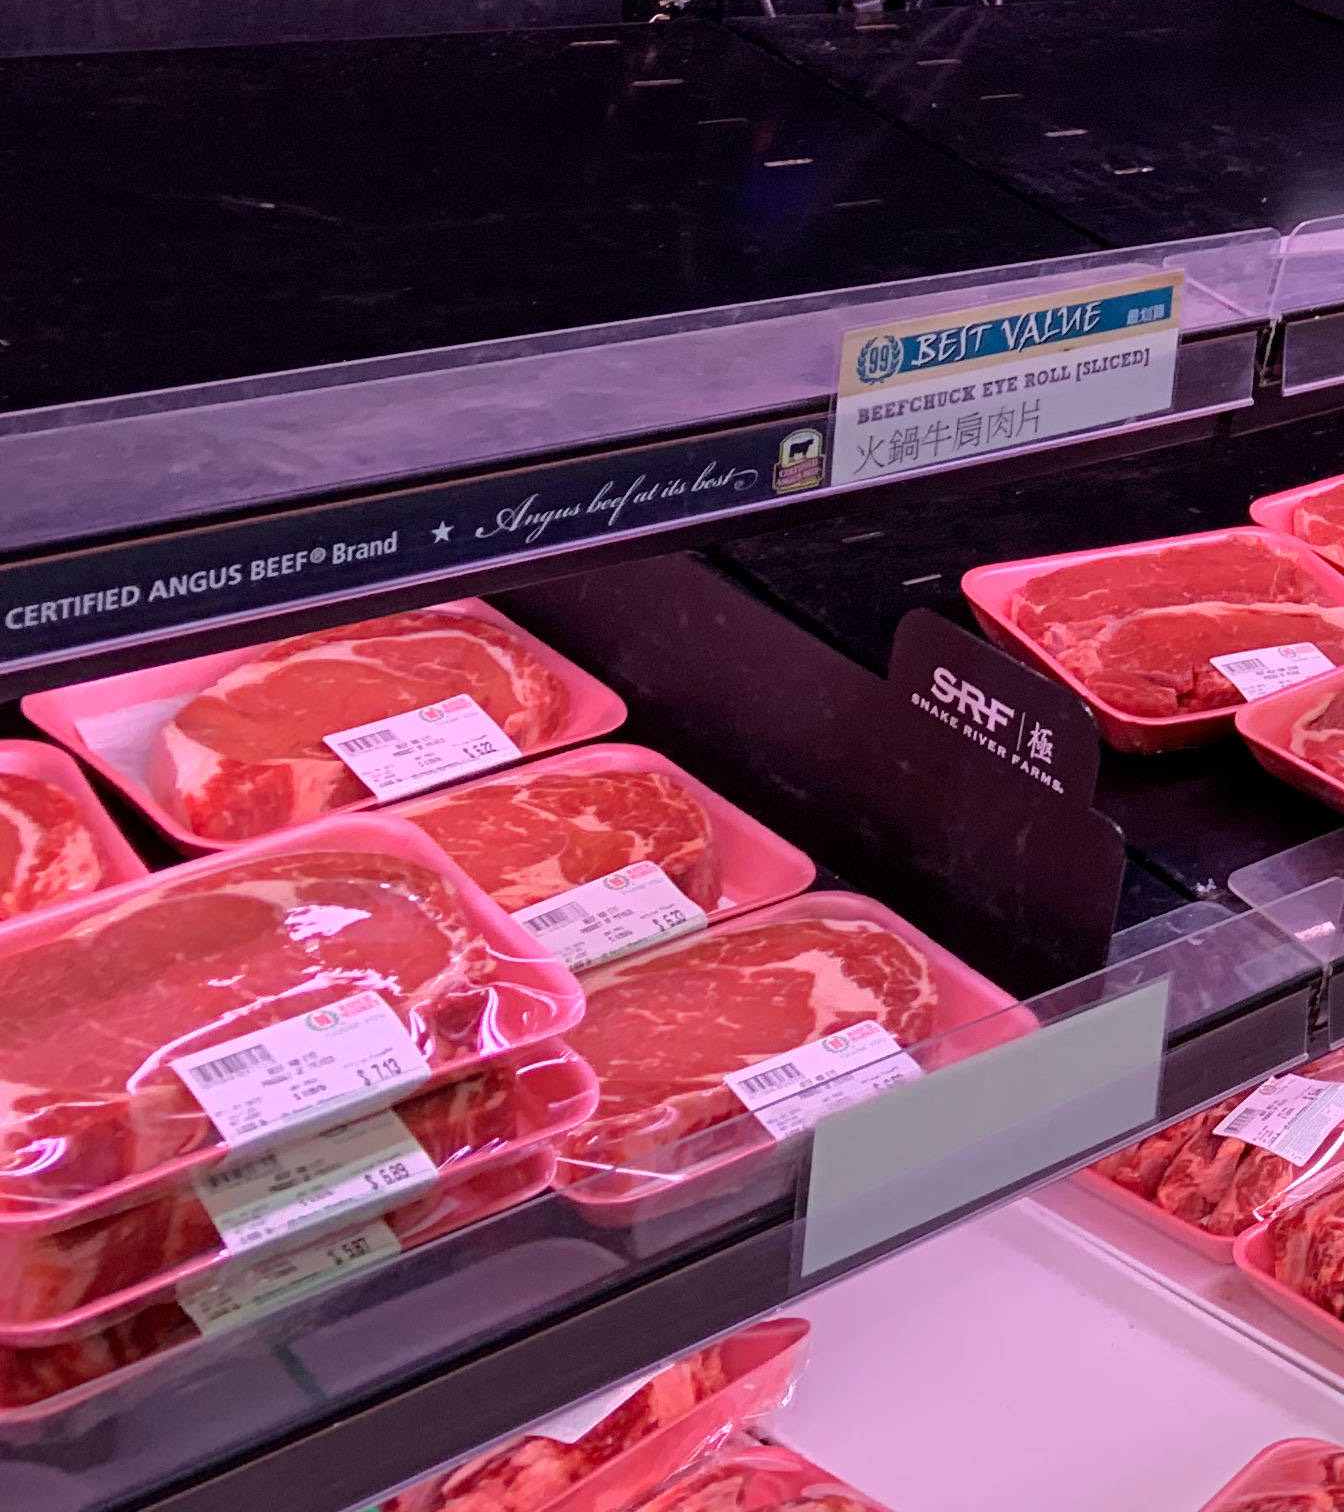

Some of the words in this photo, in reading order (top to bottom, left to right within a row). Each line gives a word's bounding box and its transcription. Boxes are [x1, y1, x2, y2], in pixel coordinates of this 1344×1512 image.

[867, 347, 891, 373] 99
[911, 323, 993, 367] BEST
[1000, 302, 1101, 352] VALUE
[857, 384, 976, 424] BEEFCHUCK
[981, 377, 1018, 398] EYE
[1024, 367, 1071, 389] ROLL
[1075, 348, 1151, 382] [SLICED]
[854, 398, 1042, 475] 火鍋牛肩肉片
[475, 493, 581, 544] Angus
[587, 474, 645, 526] beef
[633, 478, 660, 504] at
[661, 478, 685, 500] its
[692, 460, 759, 494] best
[4, 584, 140, 632] CERTIFIED
[148, 564, 243, 604] ANGUS
[332, 530, 400, 566] Brand
[911, 692, 959, 730] SNAKE
[963, 724, 1007, 759] RIVER
[931, 666, 1015, 733] SRF
